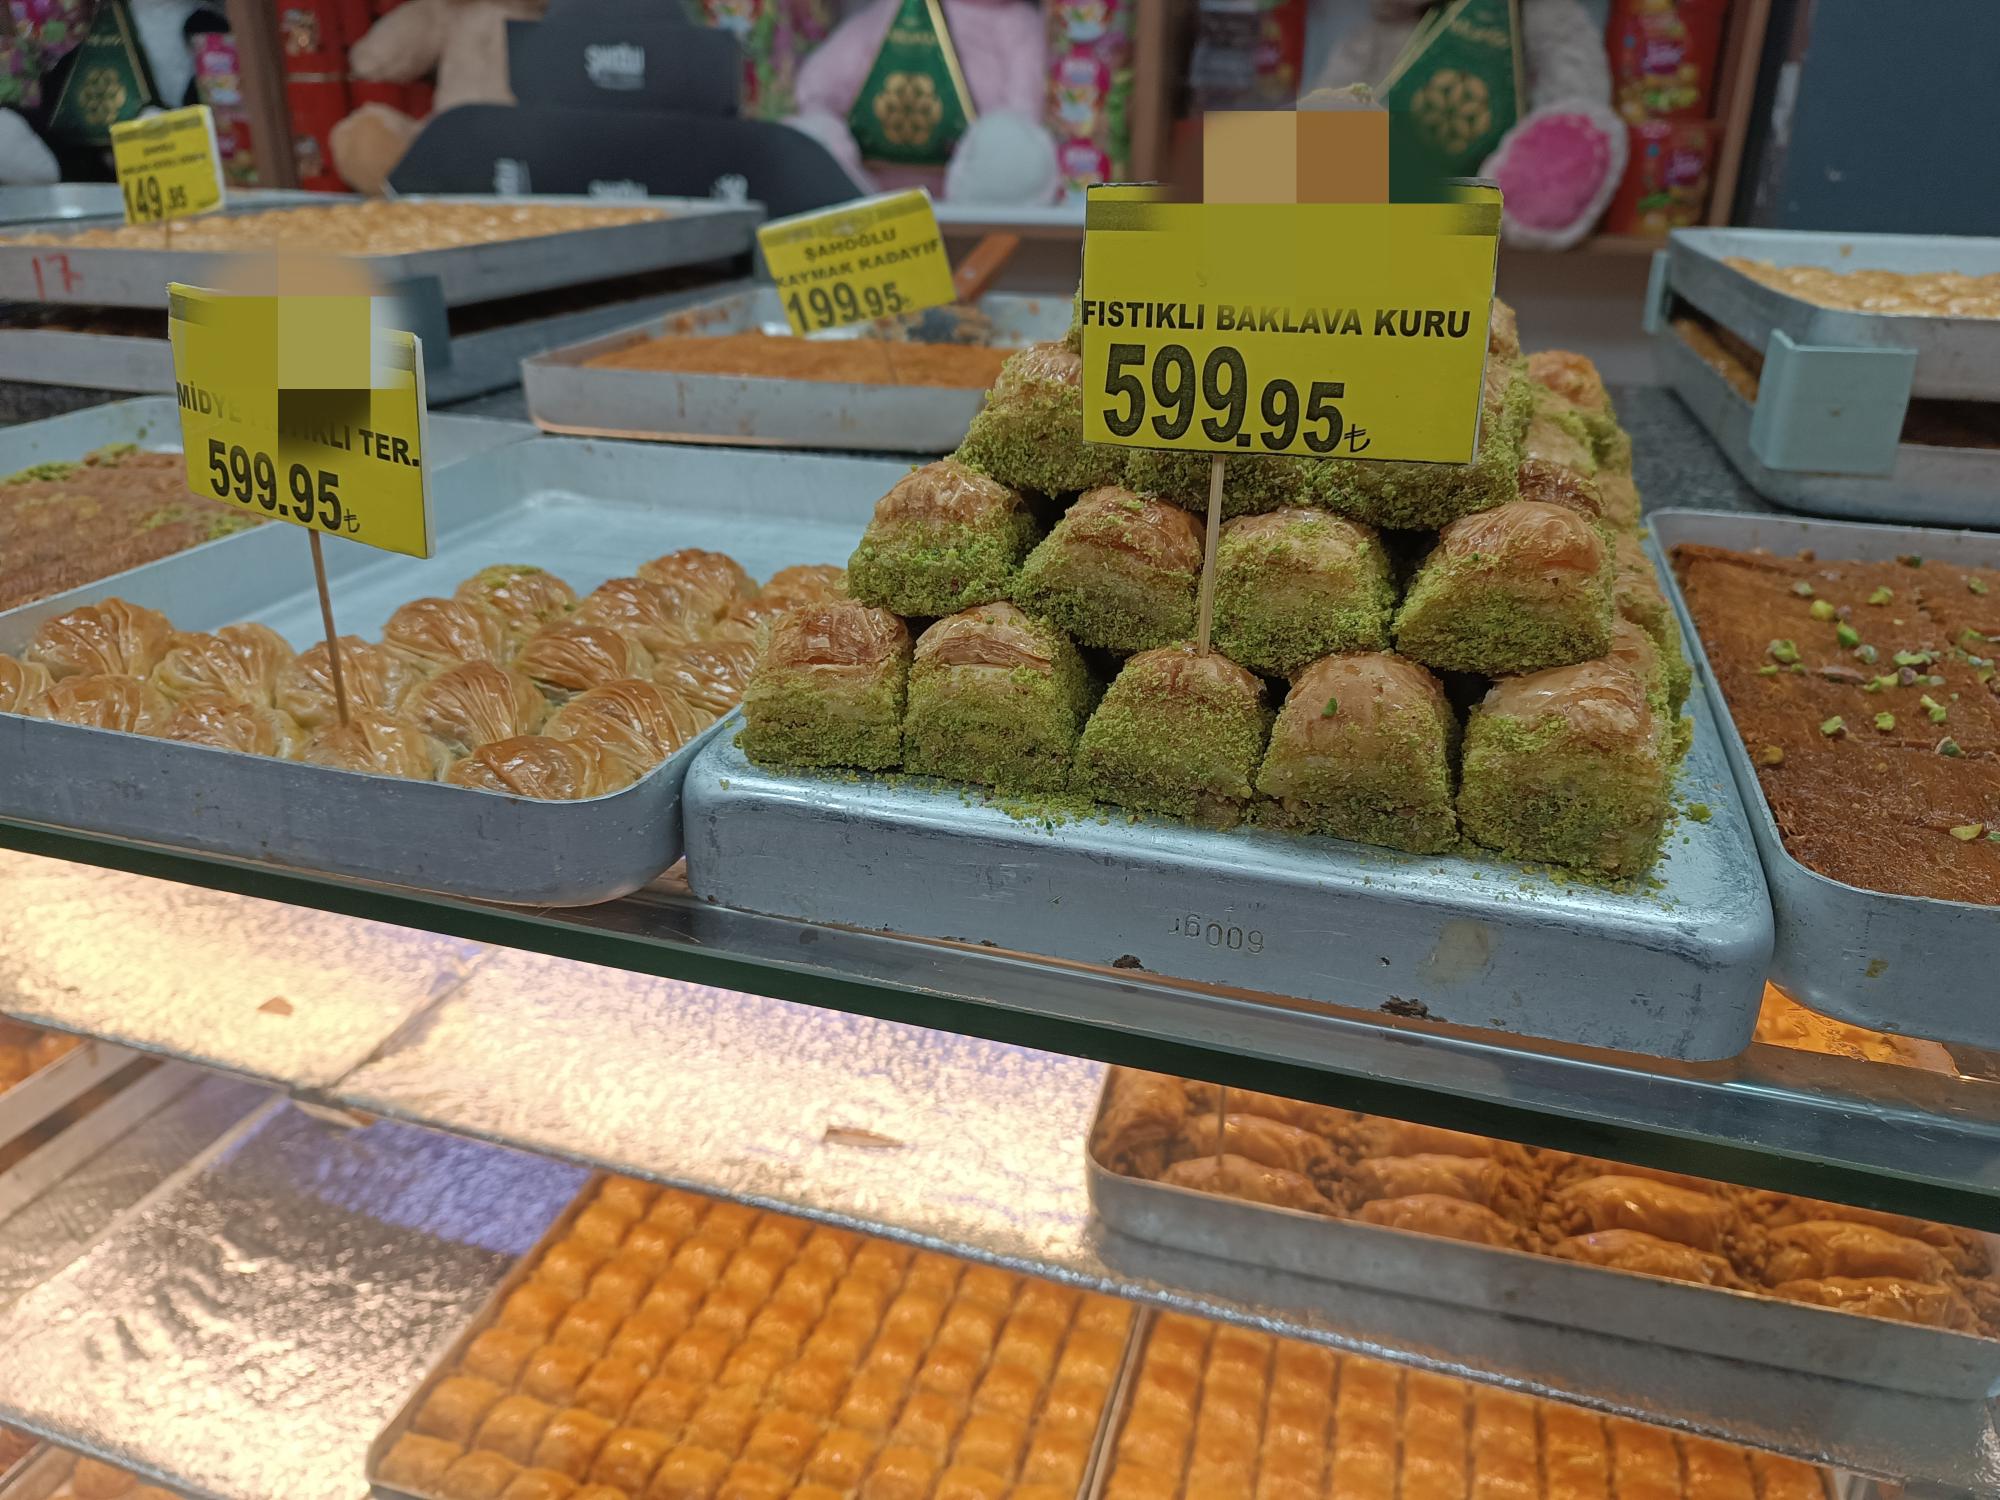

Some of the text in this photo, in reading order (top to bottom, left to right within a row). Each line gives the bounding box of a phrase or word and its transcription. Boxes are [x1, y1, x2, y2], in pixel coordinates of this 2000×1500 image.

[1083, 300, 1471, 338] FISTIKLI BAKLAVA KURU
[358, 428, 420, 468] TER.
